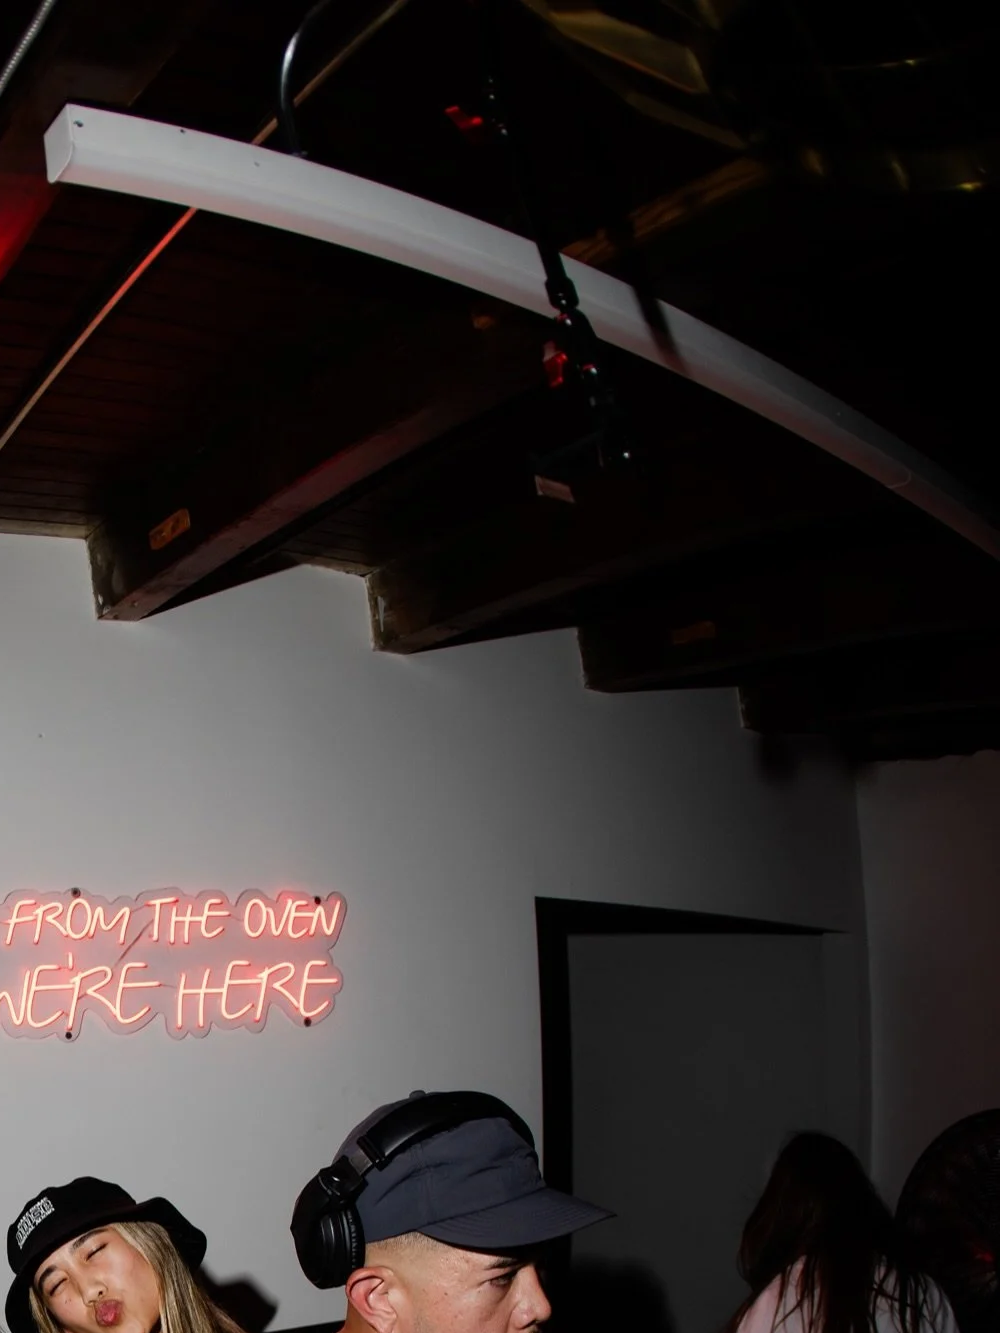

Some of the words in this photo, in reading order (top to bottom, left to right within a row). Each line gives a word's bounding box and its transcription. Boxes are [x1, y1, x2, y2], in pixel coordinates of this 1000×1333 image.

[6, 897, 130, 945] FROM
[145, 896, 230, 944] THE
[243, 897, 341, 939] OVEN
[175, 959, 338, 1028] HERE
